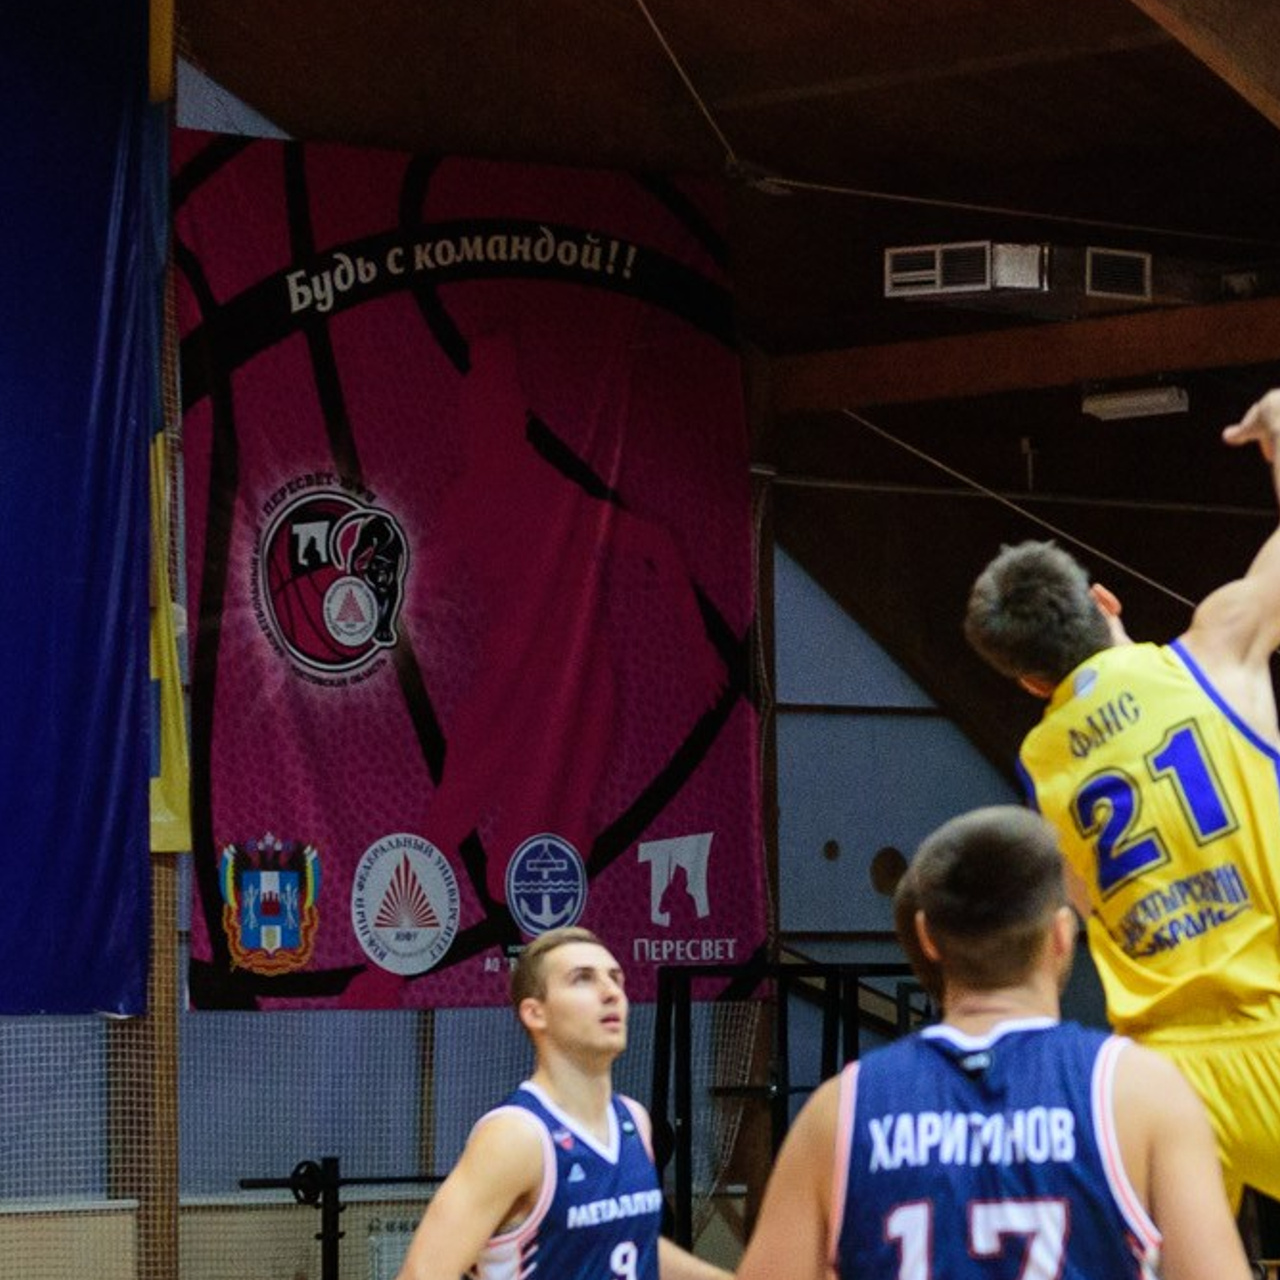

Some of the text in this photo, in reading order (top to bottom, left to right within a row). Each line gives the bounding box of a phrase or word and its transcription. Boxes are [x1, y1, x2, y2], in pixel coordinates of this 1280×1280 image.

[286, 225, 638, 314] Будь с командой!!
[1069, 717, 1240, 903] 21
[633, 937, 738, 962] ПЕРЕСВЕТ
